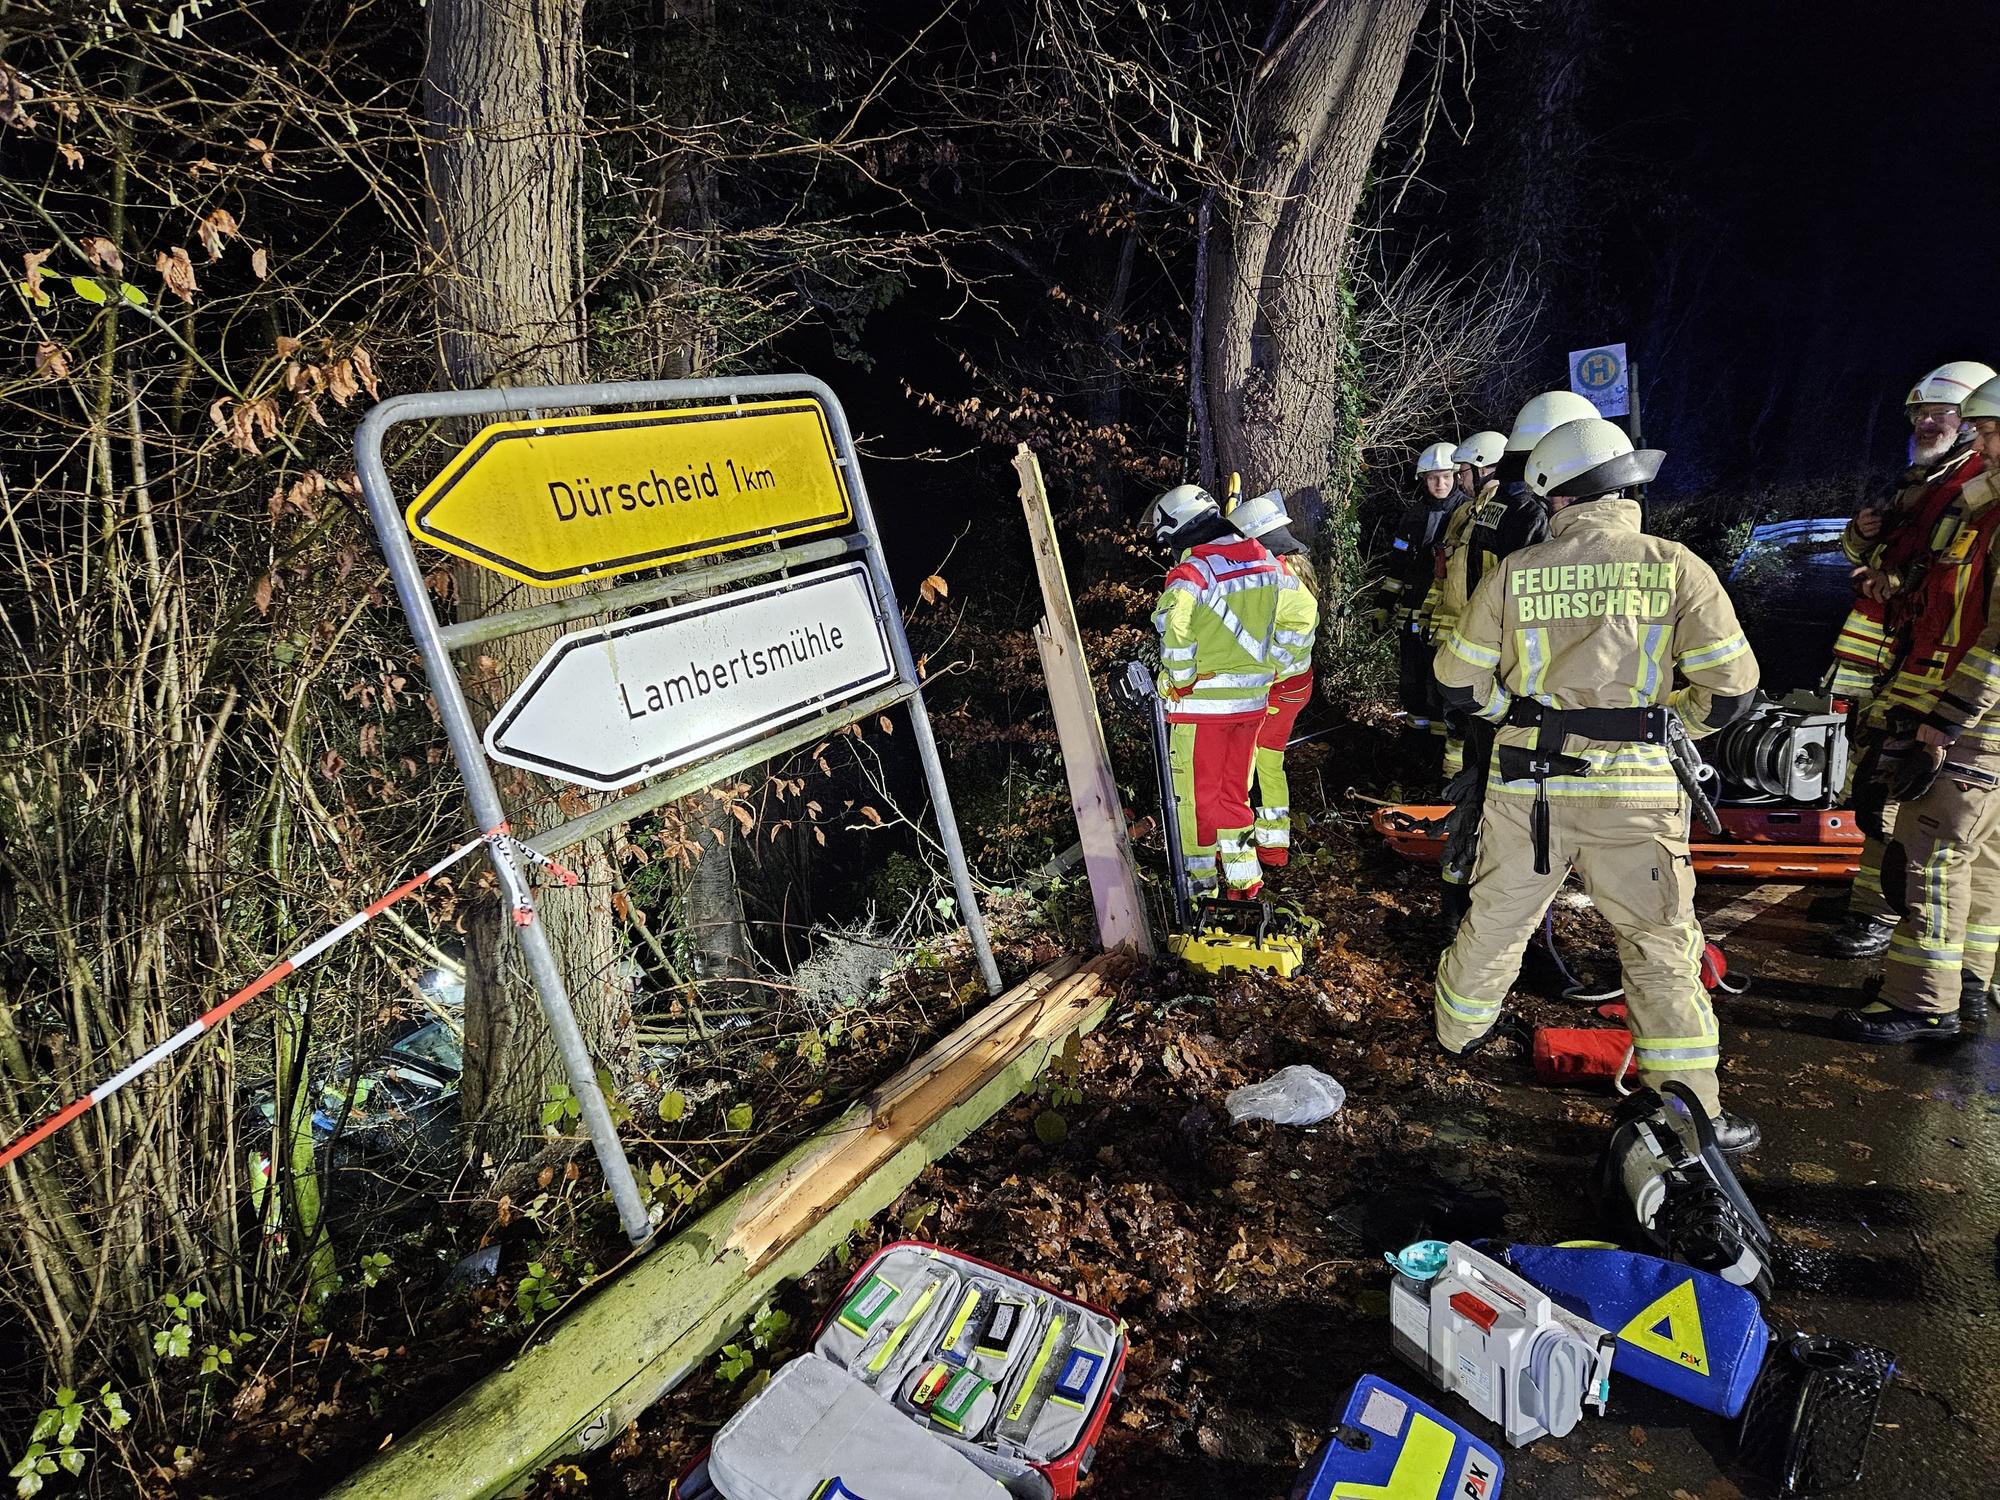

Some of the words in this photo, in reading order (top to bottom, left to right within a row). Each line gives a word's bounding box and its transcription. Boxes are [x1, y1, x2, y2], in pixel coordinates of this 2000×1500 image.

[547, 462, 719, 522] Dürscheid
[1511, 561, 1676, 596] FEUERWEHR
[1517, 588, 1671, 622] BURSCHEID
[619, 622, 844, 720] Lambertsmühle
[1680, 1351, 1702, 1367] PAX
[1463, 1461, 1490, 1500] PAX
